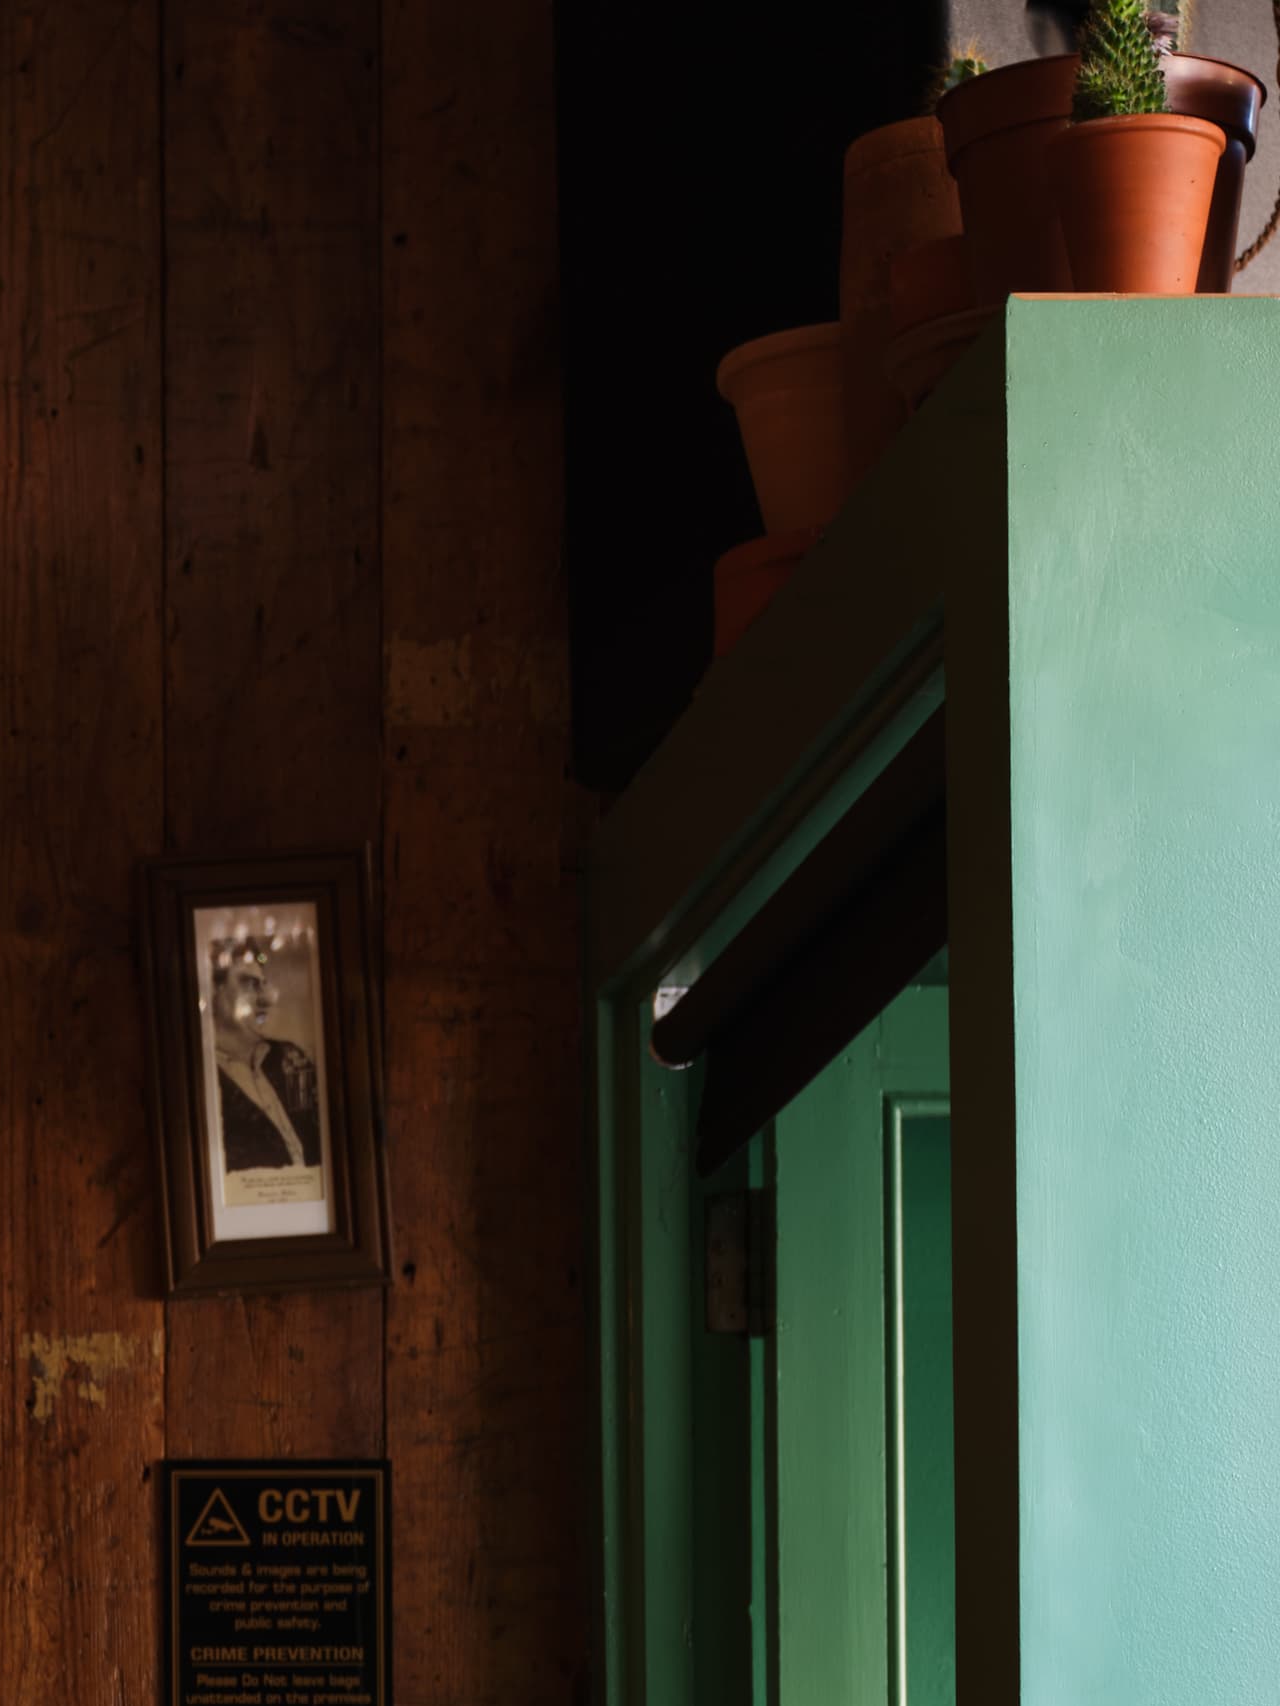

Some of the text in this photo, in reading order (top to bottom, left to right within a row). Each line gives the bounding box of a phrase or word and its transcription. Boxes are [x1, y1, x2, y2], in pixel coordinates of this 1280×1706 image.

[257, 1487, 362, 1523] CCTV
[262, 1531, 365, 1546] IN OPERATION
[332, 1562, 367, 1580] being
[185, 1580, 244, 1595] recorded
[248, 1580, 268, 1595] for
[272, 1580, 296, 1595] the
[300, 1583, 353, 1598] purpose
[209, 1598, 348, 1616] crime prevention and
[234, 1616, 272, 1632] public
[191, 1647, 365, 1662] CRIME PREVENTION
[196, 1673, 238, 1687] Please
[241, 1673, 260, 1687] Do
[263, 1673, 288, 1687] Not
[186, 1691, 262, 1705] unattended
[266, 1694, 281, 1705] on
[285, 1691, 309, 1705] the
